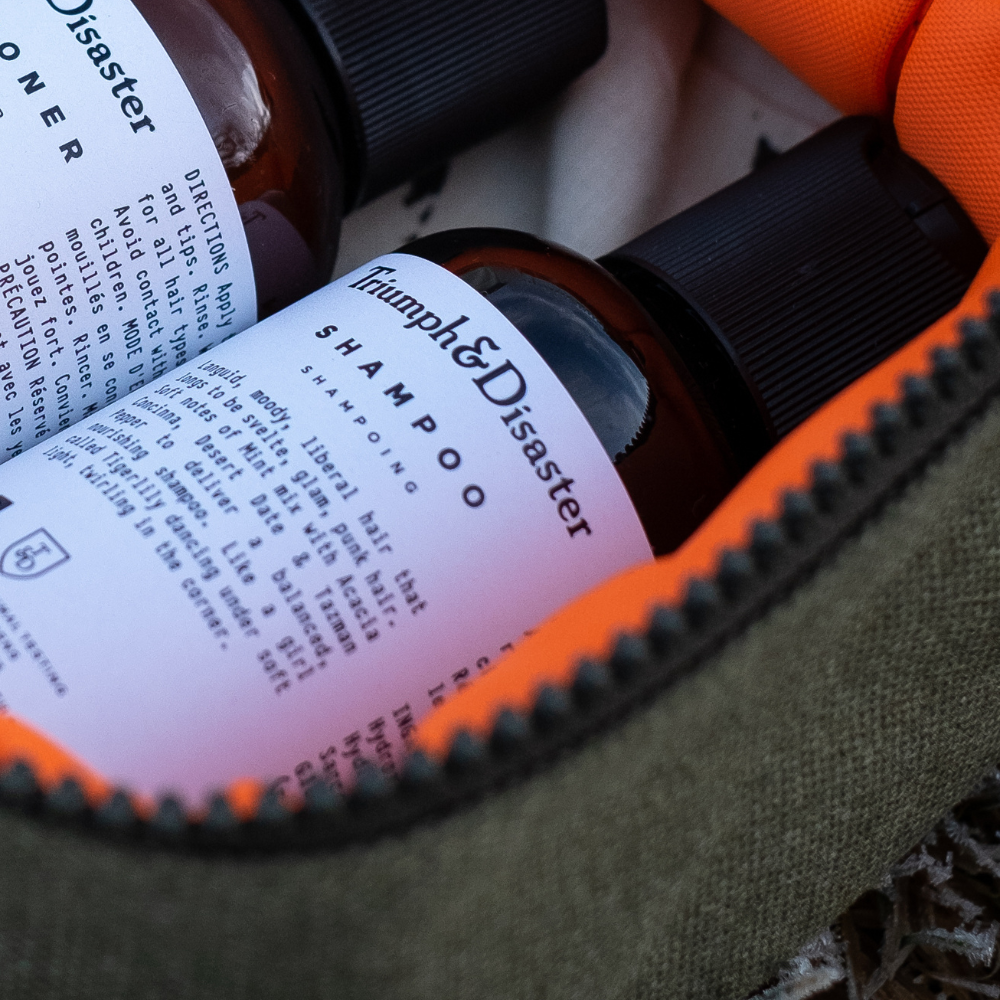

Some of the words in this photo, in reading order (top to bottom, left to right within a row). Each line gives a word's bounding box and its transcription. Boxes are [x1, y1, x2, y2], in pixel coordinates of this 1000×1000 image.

[65, 228, 103, 314] mouillés
[113, 205, 146, 261] Avoid
[138, 194, 158, 224] for
[153, 237, 175, 269] all
[165, 275, 185, 314] hair
[161, 183, 185, 216] and
[177, 225, 197, 276] tips.
[192, 283, 209, 338] Rinse.
[184, 169, 229, 275] DIRECTIONS
[215, 282, 236, 328] Apply
[14, 254, 47, 308] jouez
[41, 317, 64, 366] fort.
[38, 241, 77, 325] pointes.
[73, 333, 92, 398] Rincer.
[90, 218, 127, 311] children.
[122, 318, 142, 360] MODE
[136, 270, 164, 338] contact
[97, 324, 110, 344] en
[102, 352, 115, 370] se
[149, 344, 171, 382] with
[8, 406, 24, 435] les
[29, 376, 51, 438] Réservé
[132, 396, 182, 430] Concinna,
[194, 434, 243, 480] Desert
[180, 397, 217, 422] notes
[218, 425, 242, 439] of
[238, 442, 275, 478] Mint
[300, 365, 418, 494] SHAMPOING
[315, 325, 485, 508] SHAMPOO
[347, 265, 593, 539] Triumph&Disaster
[65, 435, 107, 455] called
[102, 451, 165, 511] Tigerlily
[156, 433, 174, 449] to
[184, 461, 238, 513] deliver
[207, 385, 225, 399] to
[223, 396, 243, 413] be
[242, 414, 288, 466] svelte,
[291, 470, 329, 517] glam,
[249, 389, 291, 430] moody,
[301, 436, 358, 500] liberal
[79, 464, 135, 517] twirling
[155, 467, 208, 527] shampoo.
